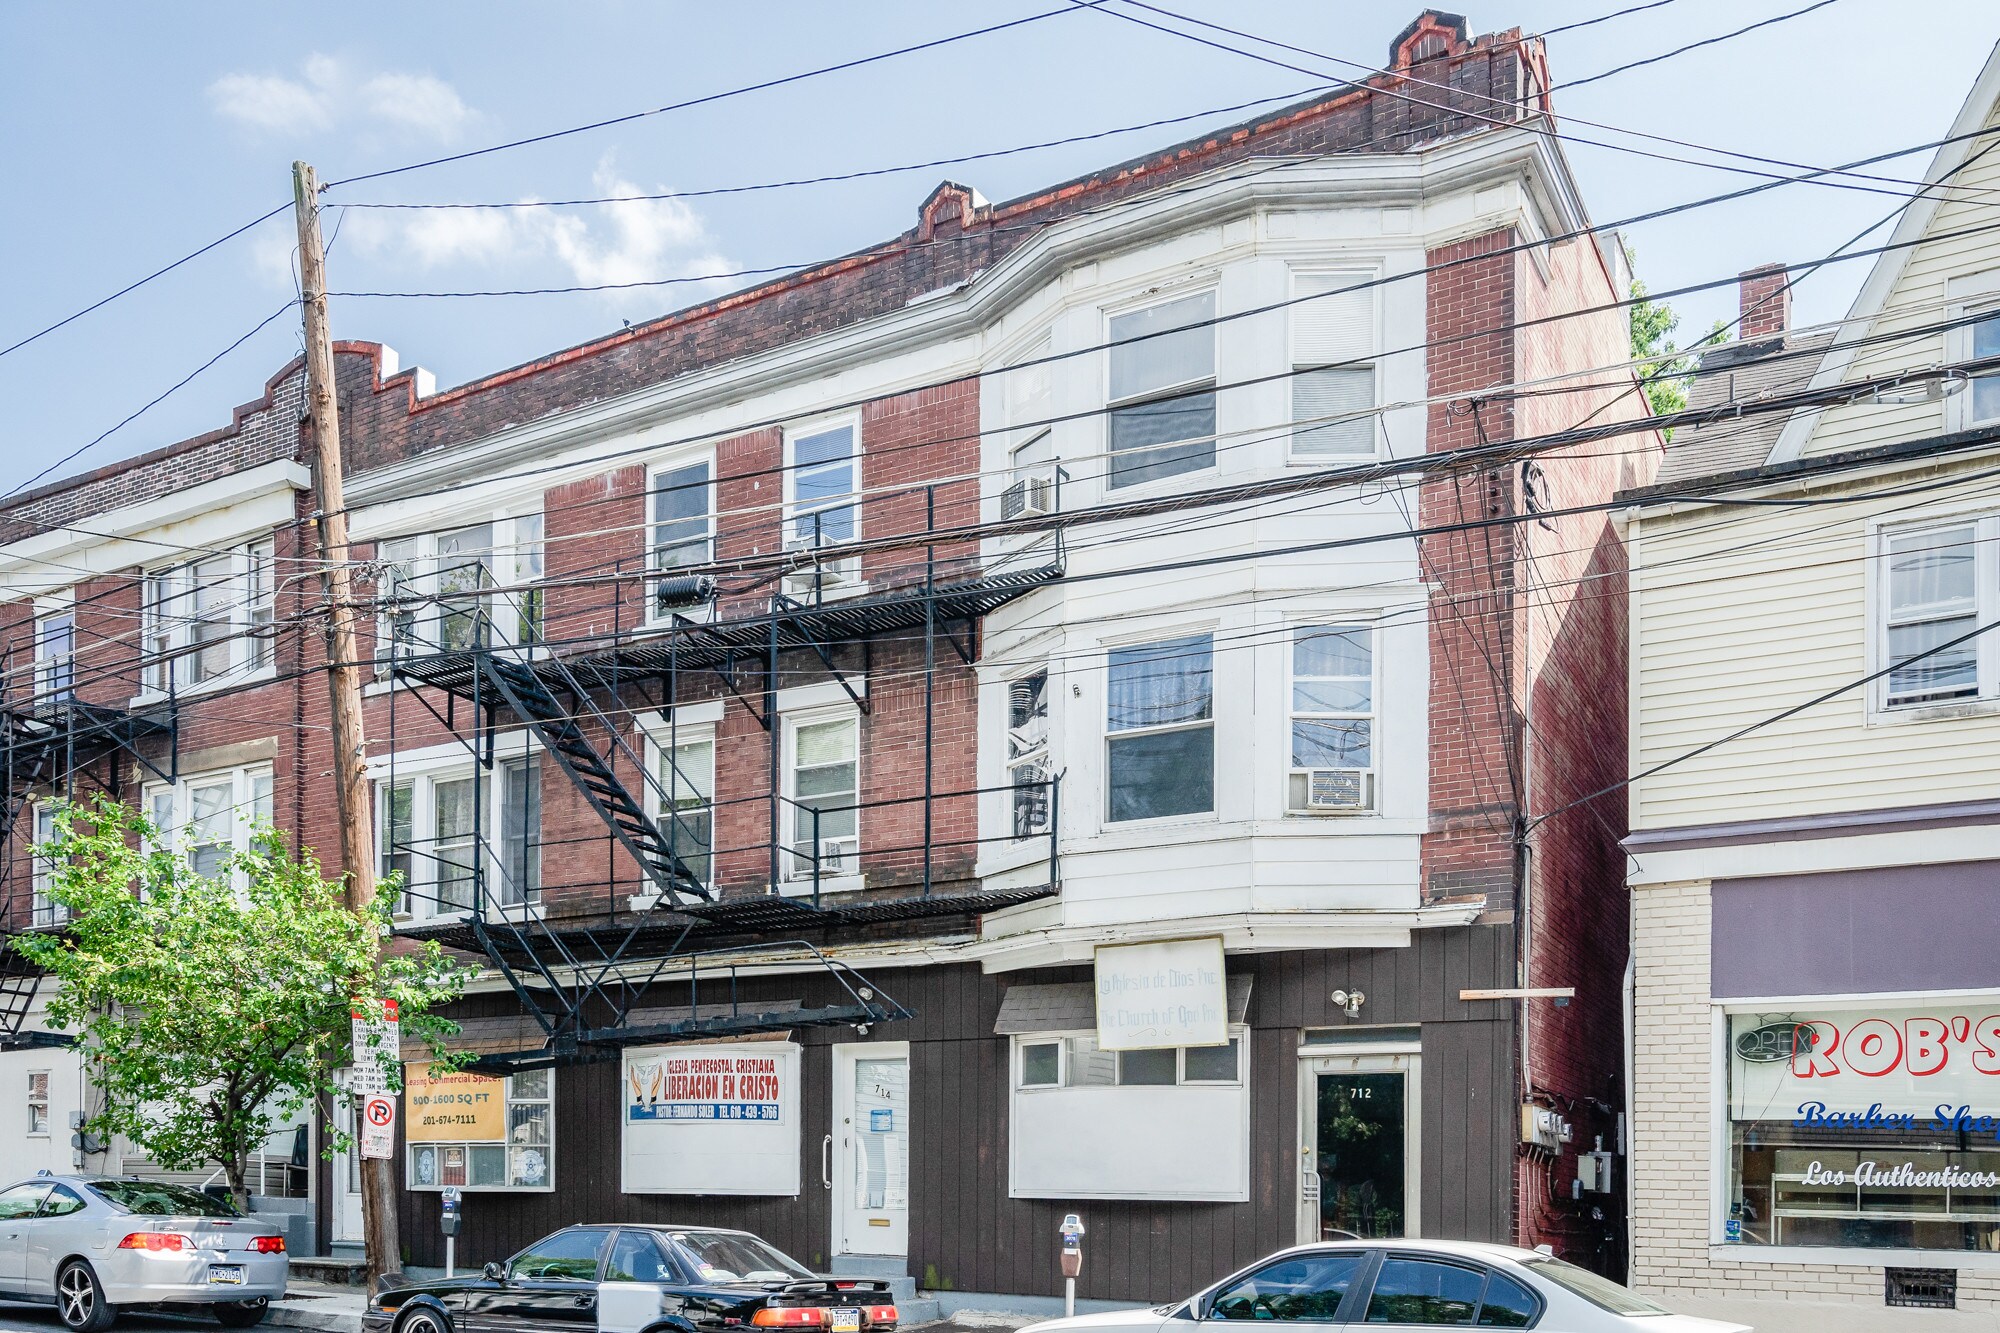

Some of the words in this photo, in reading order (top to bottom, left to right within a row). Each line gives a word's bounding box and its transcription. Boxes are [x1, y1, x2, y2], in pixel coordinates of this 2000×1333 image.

[1736, 1030, 1812, 1053] OPEN
[667, 1059, 689, 1074] IGLESIA
[691, 1059, 733, 1074] PENTECOSTAL
[736, 1059, 775, 1074] CRISTIANA
[664, 1075, 718, 1100] LIBERACION
[722, 1075, 735, 1100] EN
[740, 1075, 779, 1100] CRISTO
[875, 1084, 891, 1099] 714
[1350, 1088, 1371, 1099] 712
[413, 1094, 455, 1105] 800-1600
[457, 1093, 473, 1105] SQ
[475, 1093, 490, 1103] FT
[699, 1105, 715, 1118] SOLER
[1793, 1101, 1917, 1131] Barber
[423, 1115, 476, 1126] 201-674-7111
[1802, 1160, 1845, 1185] Los
[1854, 1161, 1997, 1188] Authenticos
